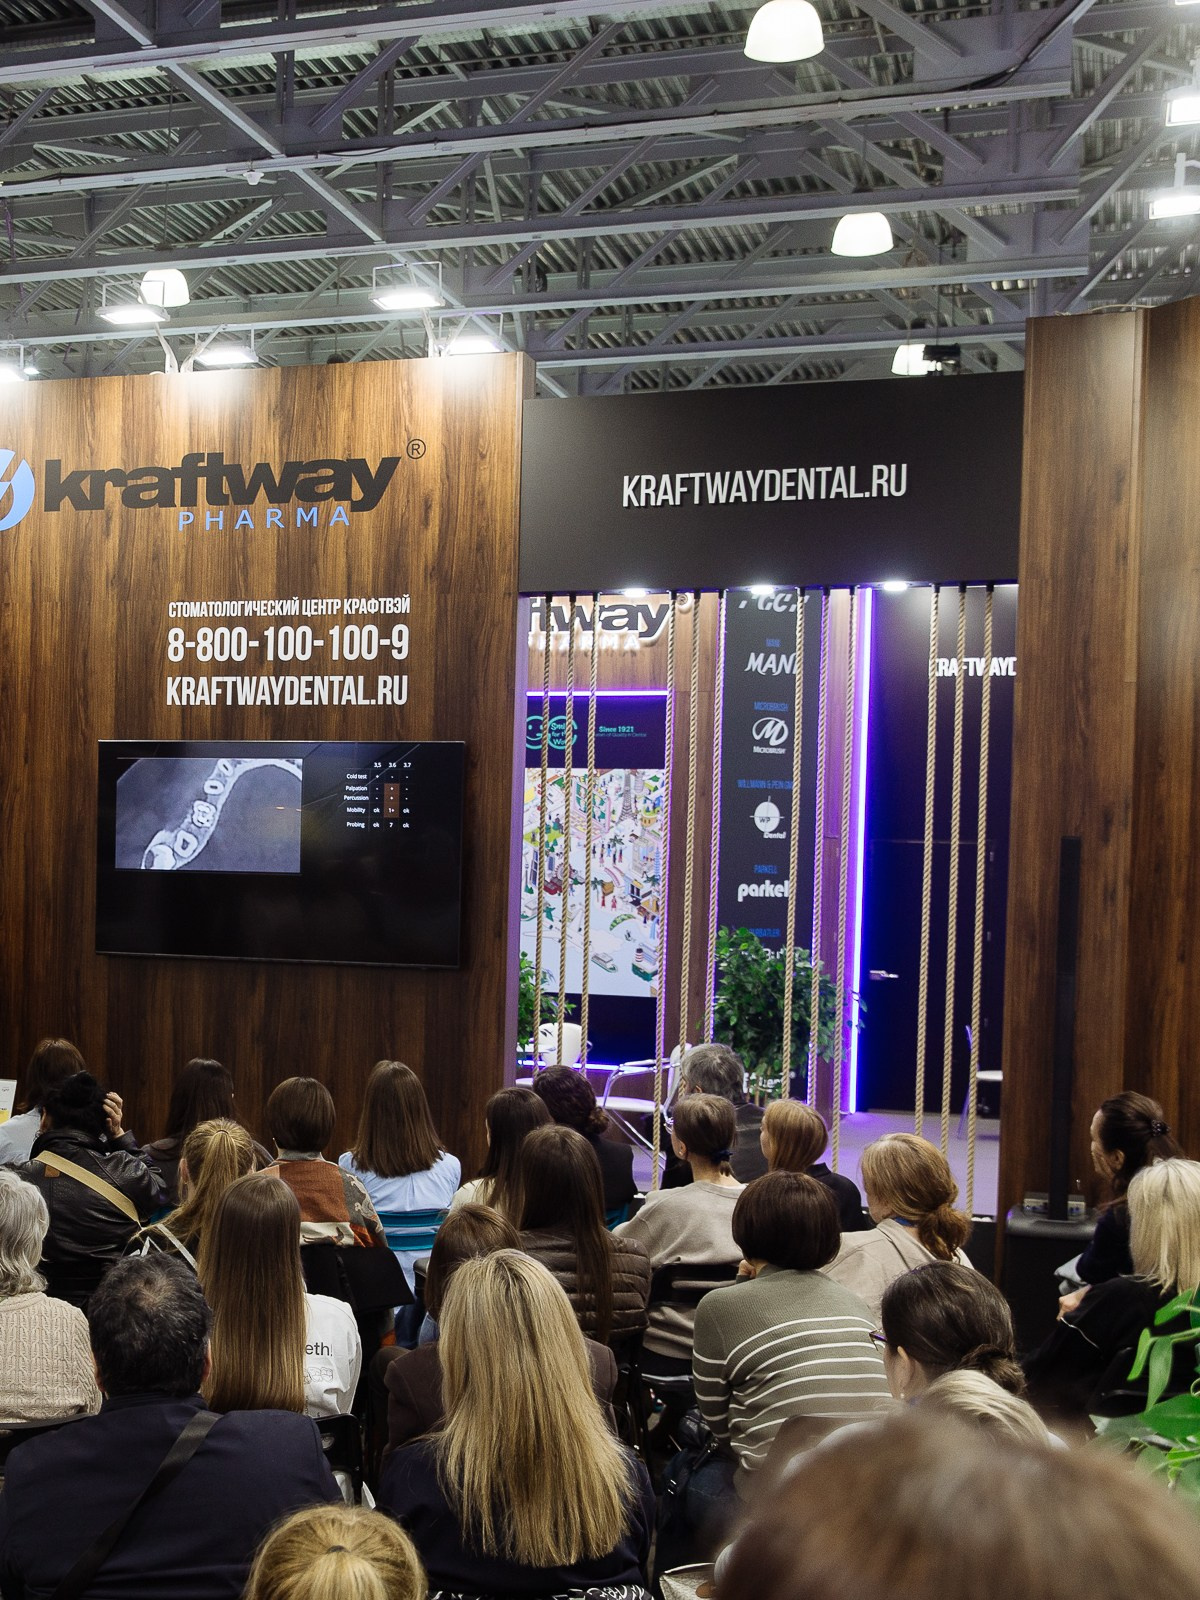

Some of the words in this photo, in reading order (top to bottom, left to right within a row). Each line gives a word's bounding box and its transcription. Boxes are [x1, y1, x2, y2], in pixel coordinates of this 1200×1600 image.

[44, 452, 401, 513] kraftway
[622, 463, 907, 508] KRAFTWAYDENTAL.RU
[178, 506, 350, 531] PHARMA
[168, 597, 299, 618] СТОМАТОЛОГИЧЕСКИЙ
[302, 599, 341, 617] ЦЕНТР
[344, 594, 411, 615] КРАФТВЭЙ
[167, 624, 409, 662] 8-800-100-100-9
[166, 675, 408, 705] KRAFTWAYDENTAL.RU
